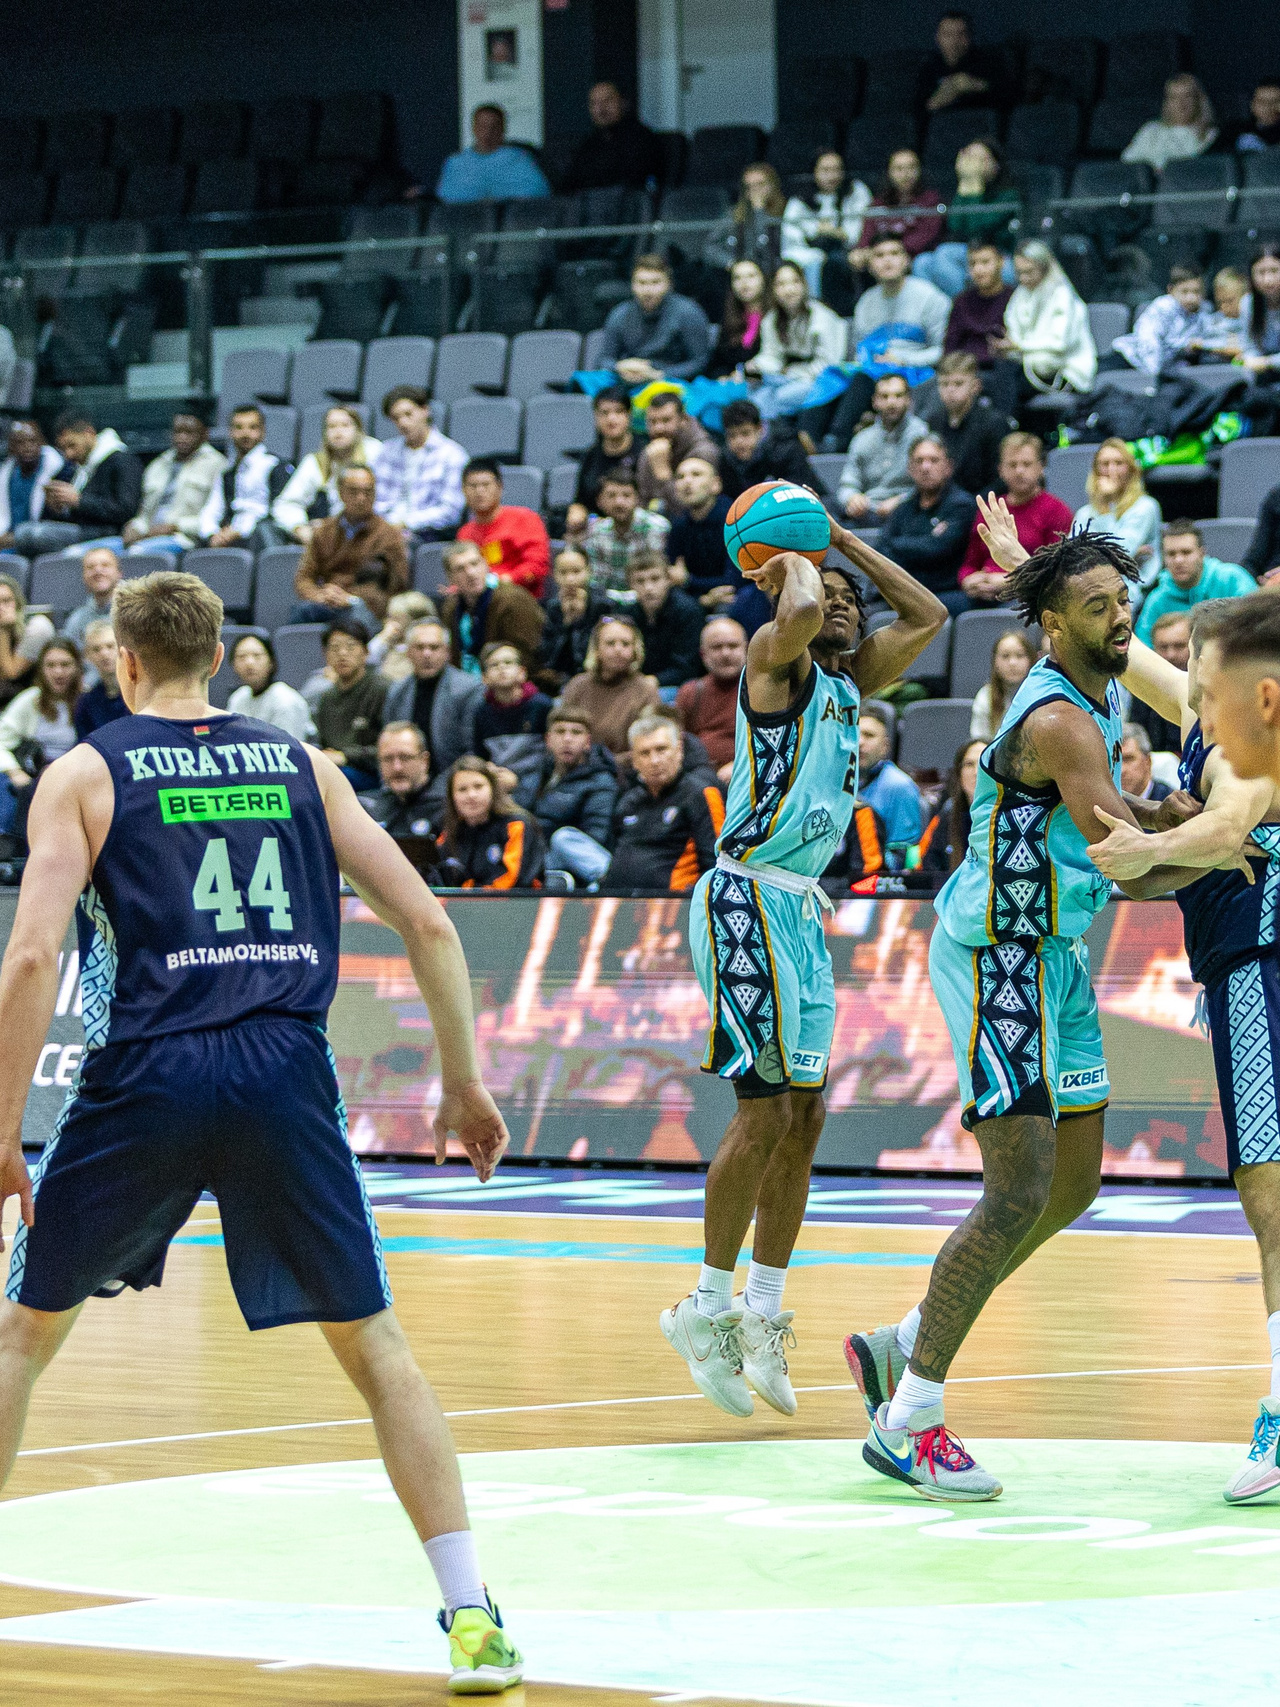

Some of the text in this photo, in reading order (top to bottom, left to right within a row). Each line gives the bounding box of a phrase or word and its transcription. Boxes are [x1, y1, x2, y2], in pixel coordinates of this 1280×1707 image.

[124, 743, 298, 780] KURATNIK
[193, 837, 293, 931] 44
[1062, 1068, 1105, 1088] 1XBET
